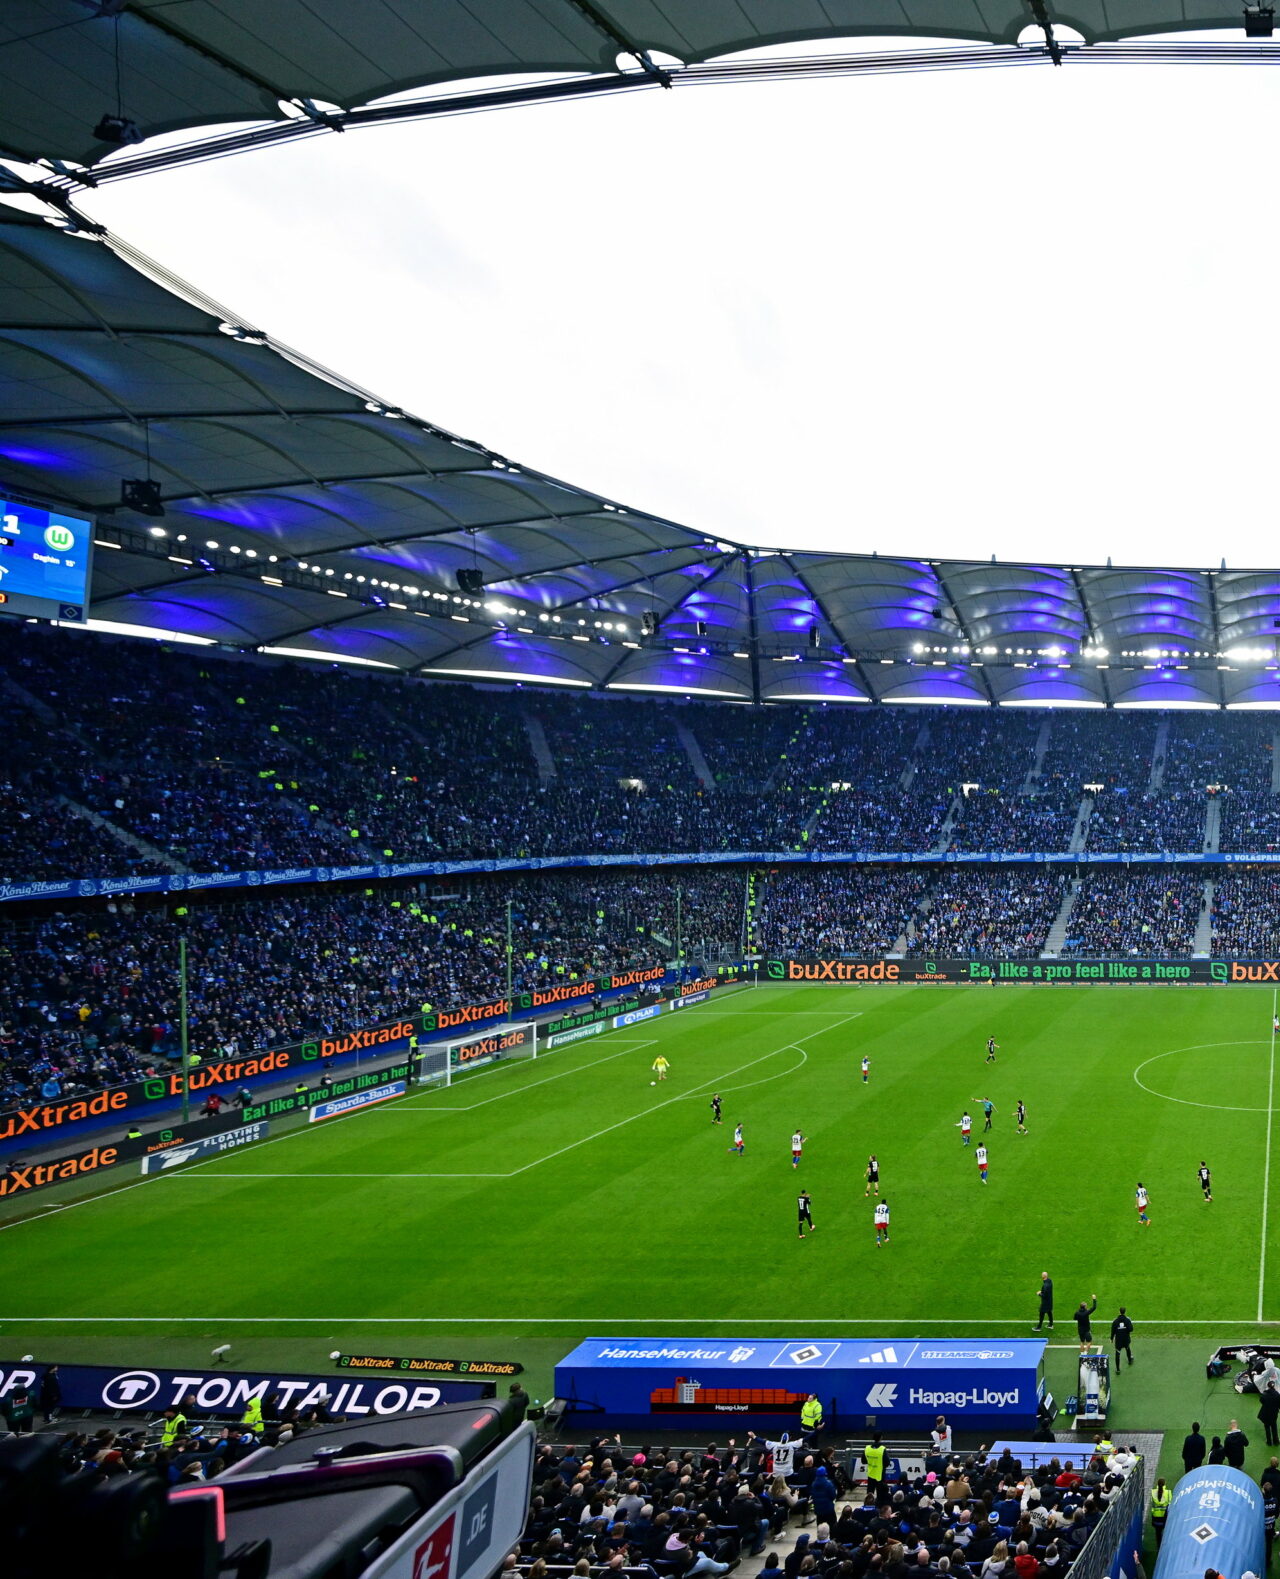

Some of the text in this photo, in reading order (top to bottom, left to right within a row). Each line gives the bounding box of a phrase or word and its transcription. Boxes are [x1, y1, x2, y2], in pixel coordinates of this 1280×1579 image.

[611, 965, 665, 988] buXtrade
[789, 960, 900, 980] buXtrade
[1000, 962, 1024, 978] like
[1033, 966, 1042, 978] a
[1047, 966, 1072, 981] pro
[1076, 962, 1105, 978] feel
[1109, 962, 1138, 978] like
[1142, 966, 1152, 978] a
[1156, 962, 1191, 979] hero
[533, 981, 596, 1006] buXtrade
[636, 1007, 654, 1020] PLAN
[321, 1022, 414, 1057] buXtrade
[553, 1027, 595, 1045] HanseMerkur
[170, 1051, 290, 1095] buXtrade
[242, 1064, 414, 1122] Eat like a pro feel like a her
[325, 1085, 397, 1113] Sparda-Bank
[203, 1124, 260, 1148] FLOATING
[219, 1132, 260, 1151] HOMES
[350, 1356, 394, 1368] buXtrade
[597, 1347, 726, 1361] HanseMerkur
[409, 1359, 454, 1371] buXtrade
[469, 1362, 514, 1374] buXtrade
[171, 1376, 441, 1416] TOM TAILOR
[909, 1388, 1019, 1408] Hapag-Lloyd
[715, 1404, 749, 1412] Hapag-Lloyd
[775, 1450, 790, 1462] 17
[466, 1502, 488, 1547] .DE
